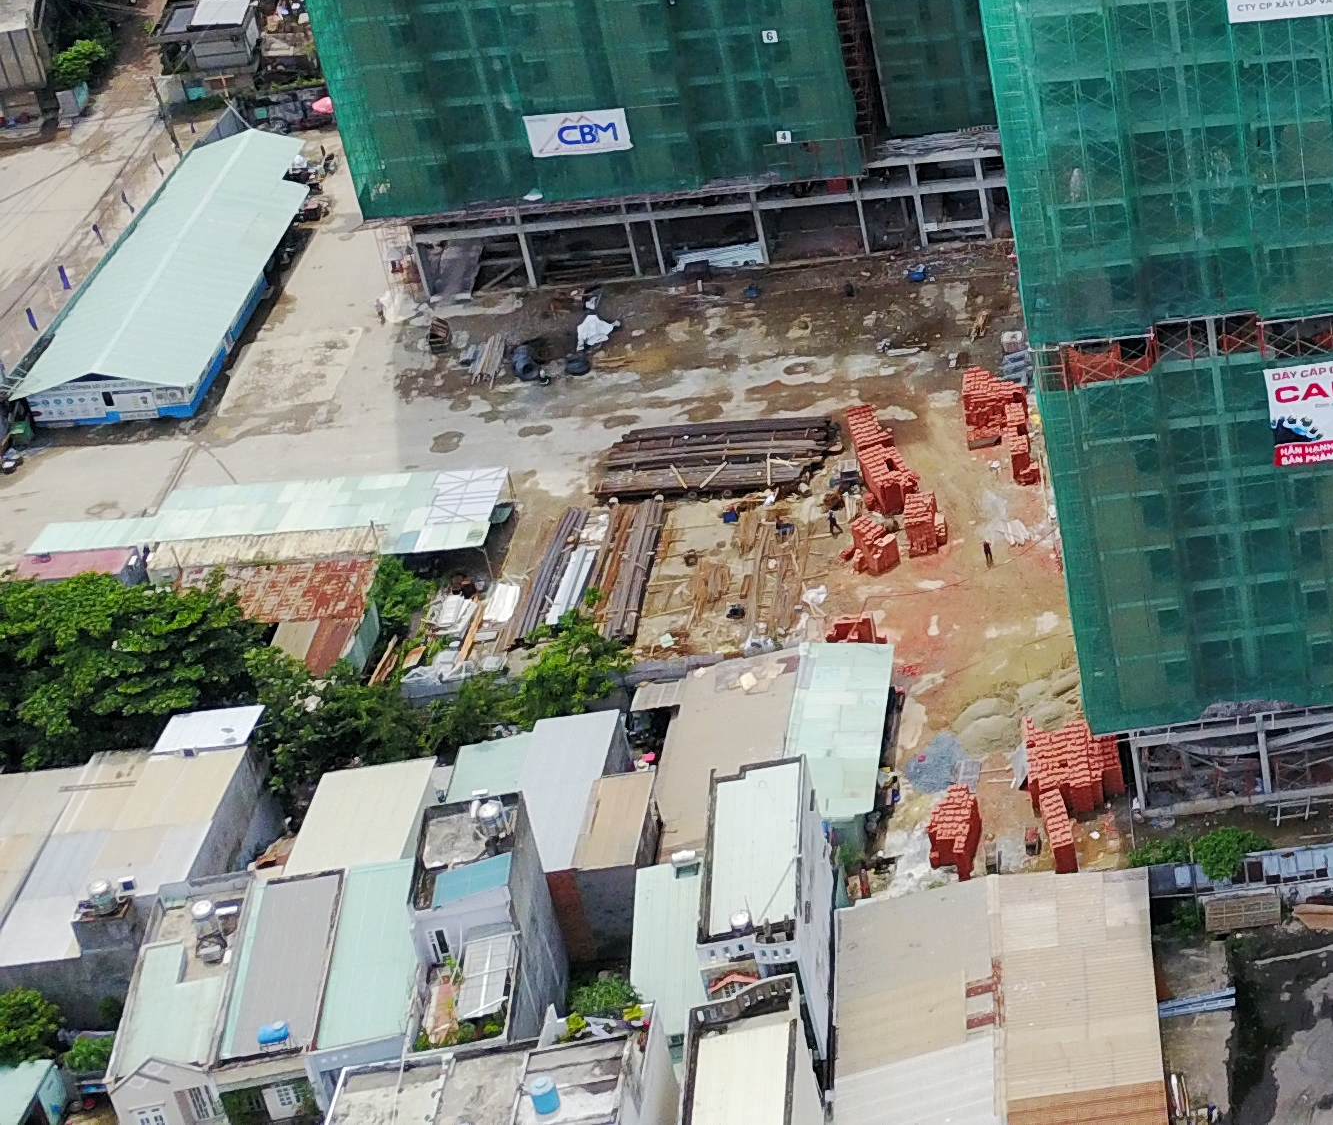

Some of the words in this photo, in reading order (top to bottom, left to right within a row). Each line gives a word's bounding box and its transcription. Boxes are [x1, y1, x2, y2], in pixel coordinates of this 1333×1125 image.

[1236, 3, 1256, 12] CTY
[1259, 1, 1273, 10] CP
[558, 122, 618, 145] CBM
